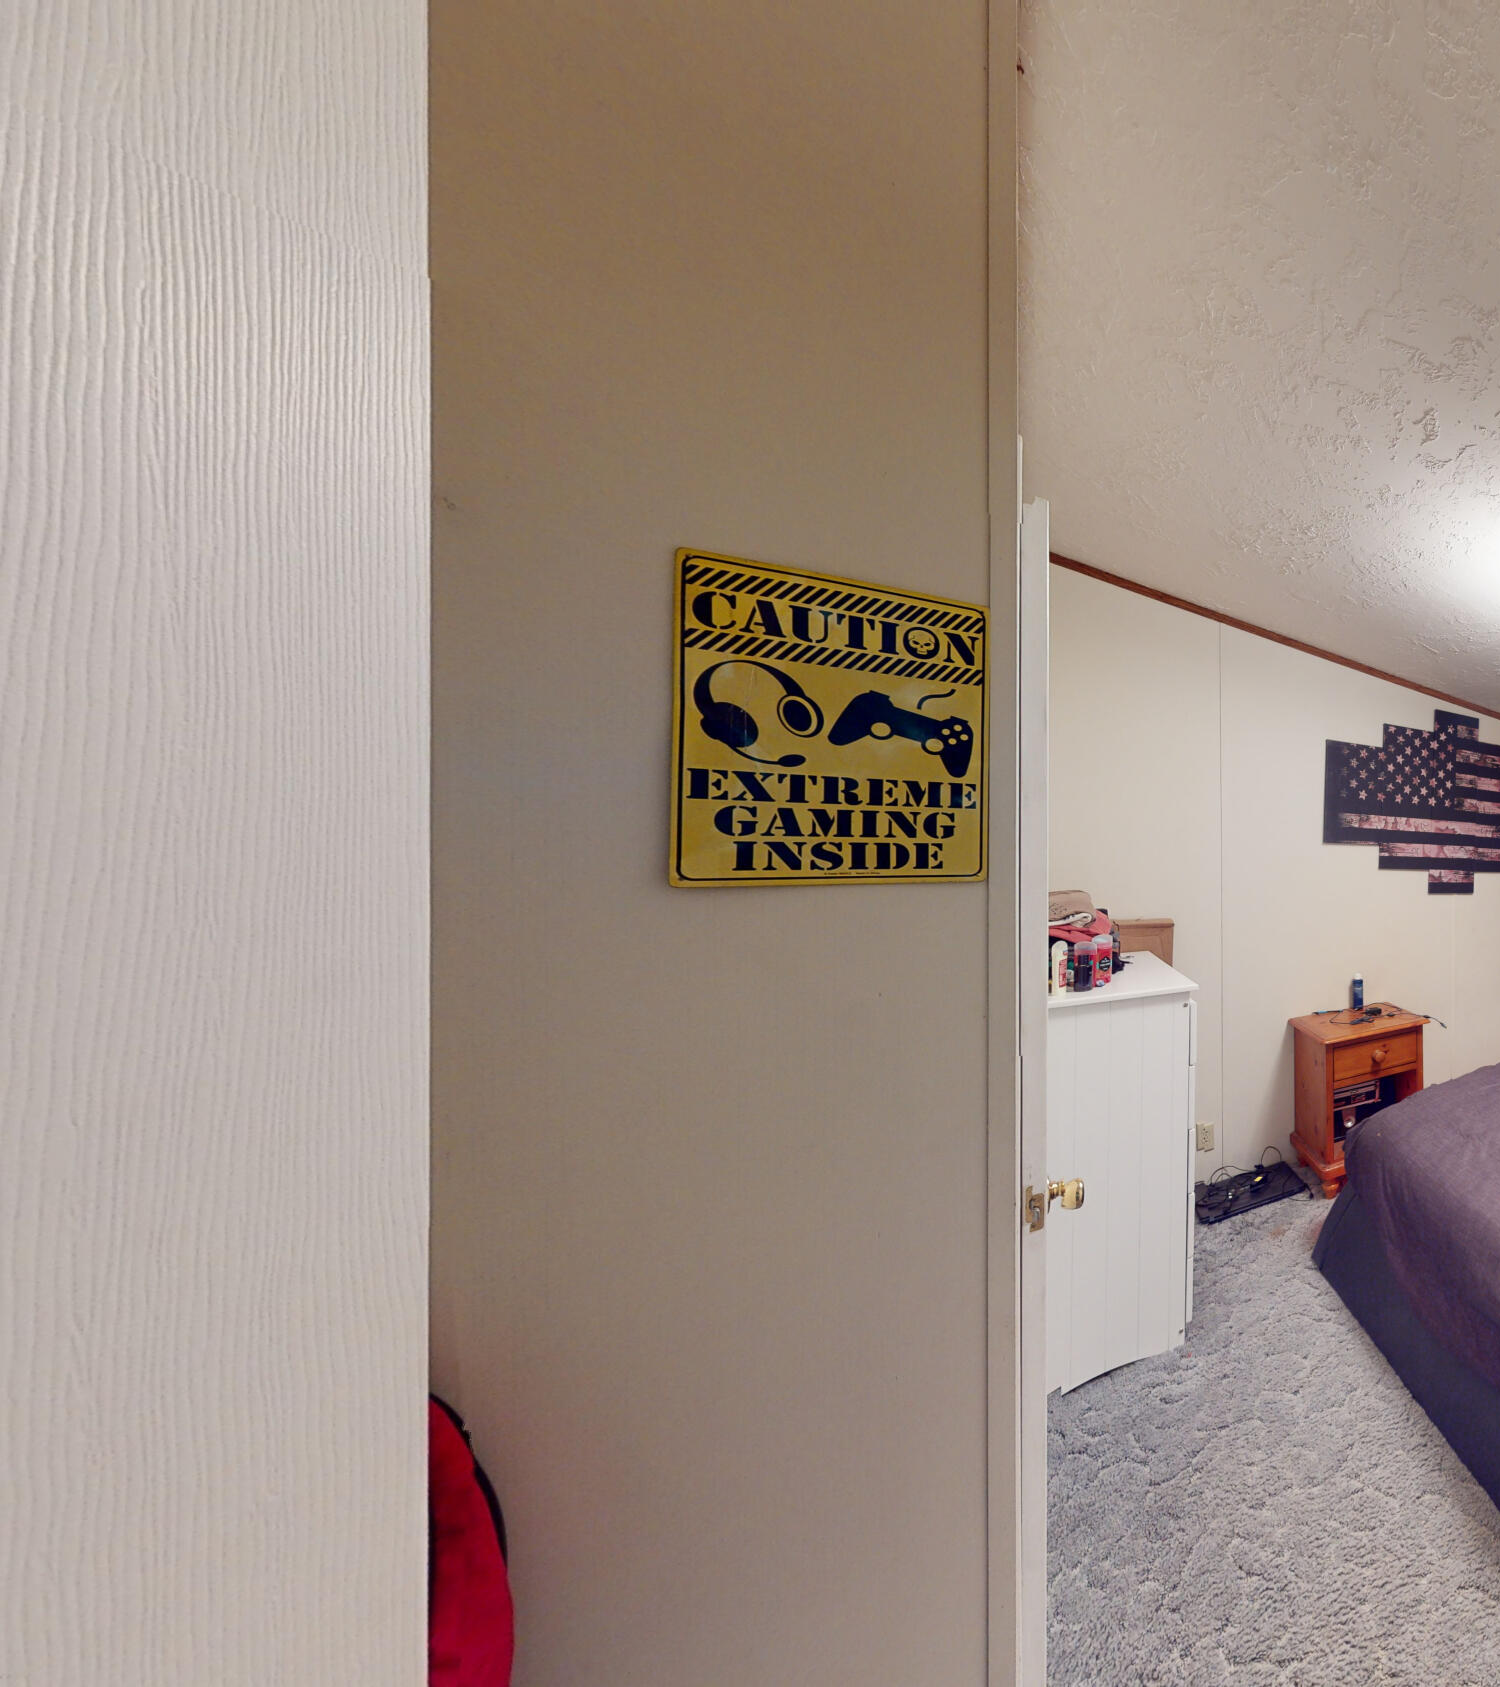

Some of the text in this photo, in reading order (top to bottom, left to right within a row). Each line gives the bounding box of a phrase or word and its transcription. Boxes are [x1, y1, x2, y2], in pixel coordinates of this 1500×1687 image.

[692, 591, 979, 667] CAUTION
[686, 767, 977, 809] EXTREME
[714, 805, 956, 839] GAMING
[732, 841, 944, 871] INSIDE
